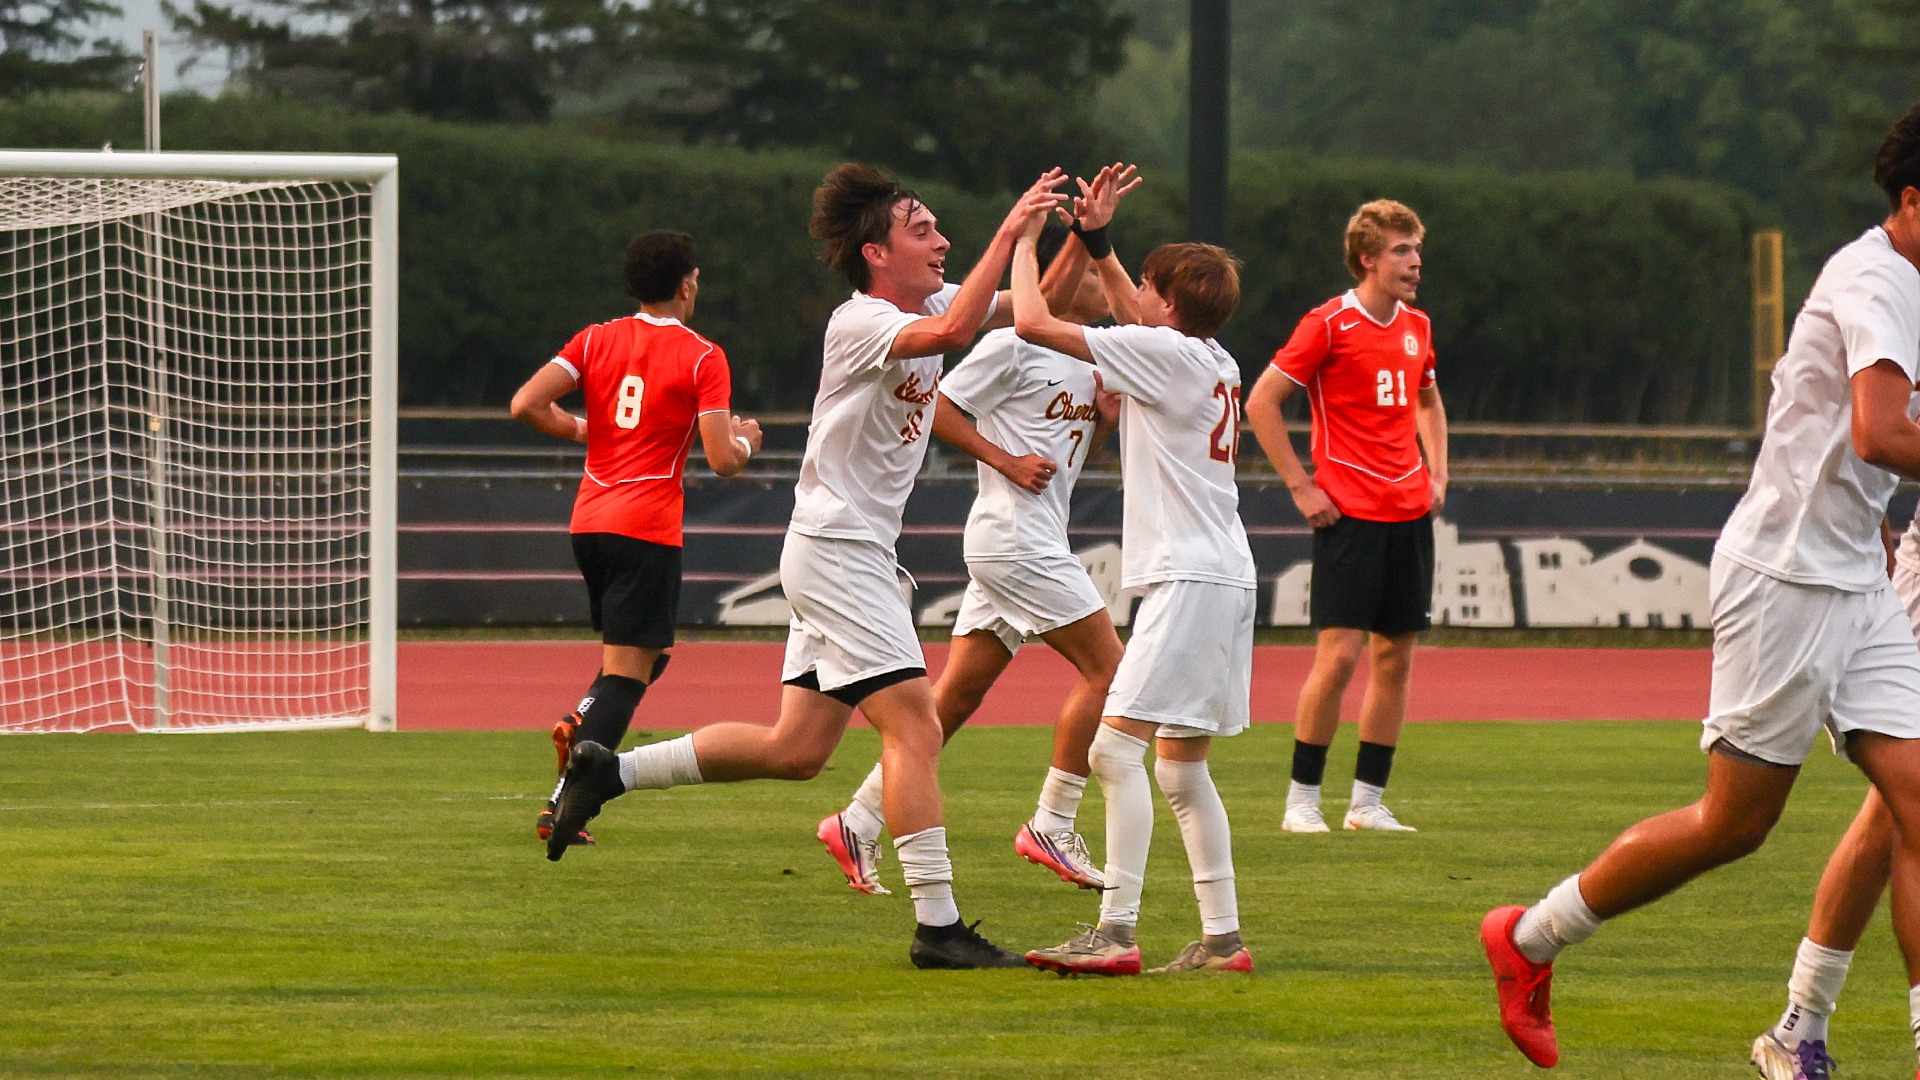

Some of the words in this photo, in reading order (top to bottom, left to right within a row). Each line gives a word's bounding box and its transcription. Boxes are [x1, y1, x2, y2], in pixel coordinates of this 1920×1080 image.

[615, 374, 645, 430] 8
[1376, 369, 1408, 407] 21
[1067, 429, 1083, 469] 7
